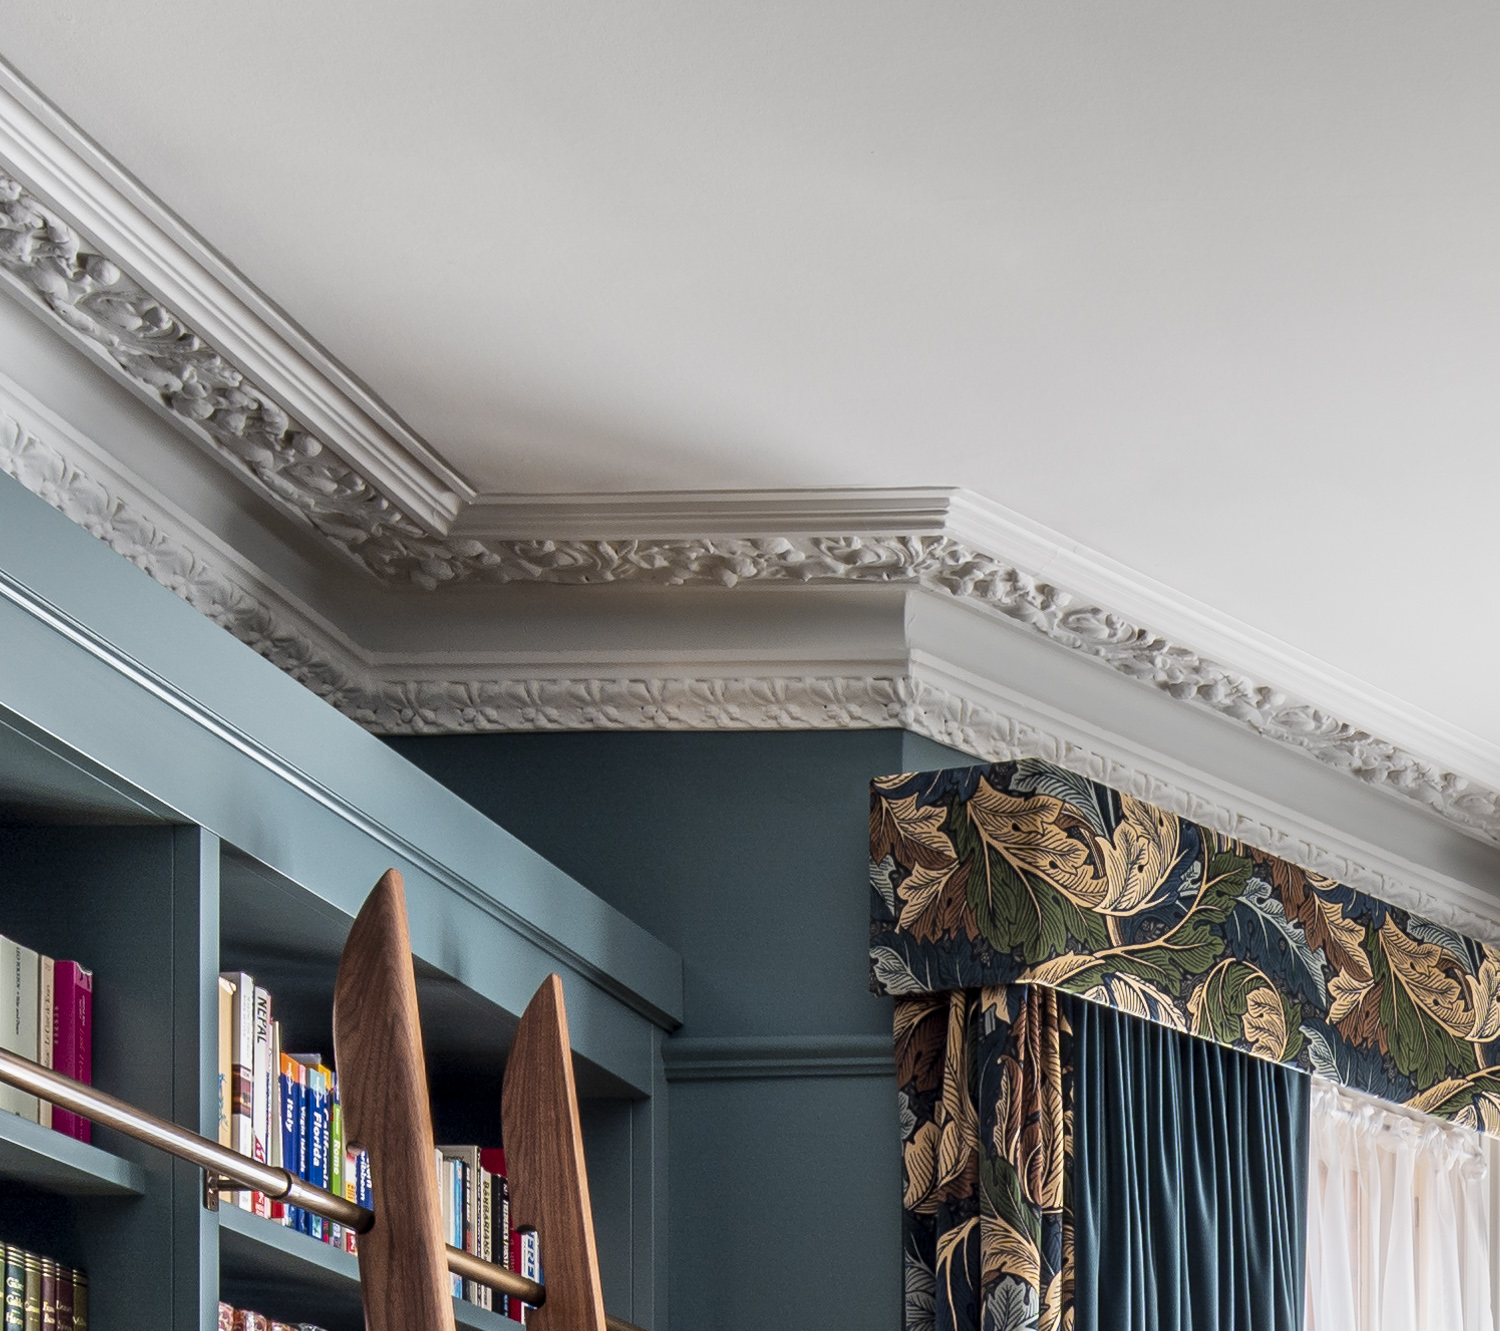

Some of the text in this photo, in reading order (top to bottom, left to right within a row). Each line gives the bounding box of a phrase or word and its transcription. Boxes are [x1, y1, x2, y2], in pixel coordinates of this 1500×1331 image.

[257, 996, 268, 1043] NEPAL
[285, 1099, 294, 1132] Italy
[312, 1111, 321, 1167] Florida
